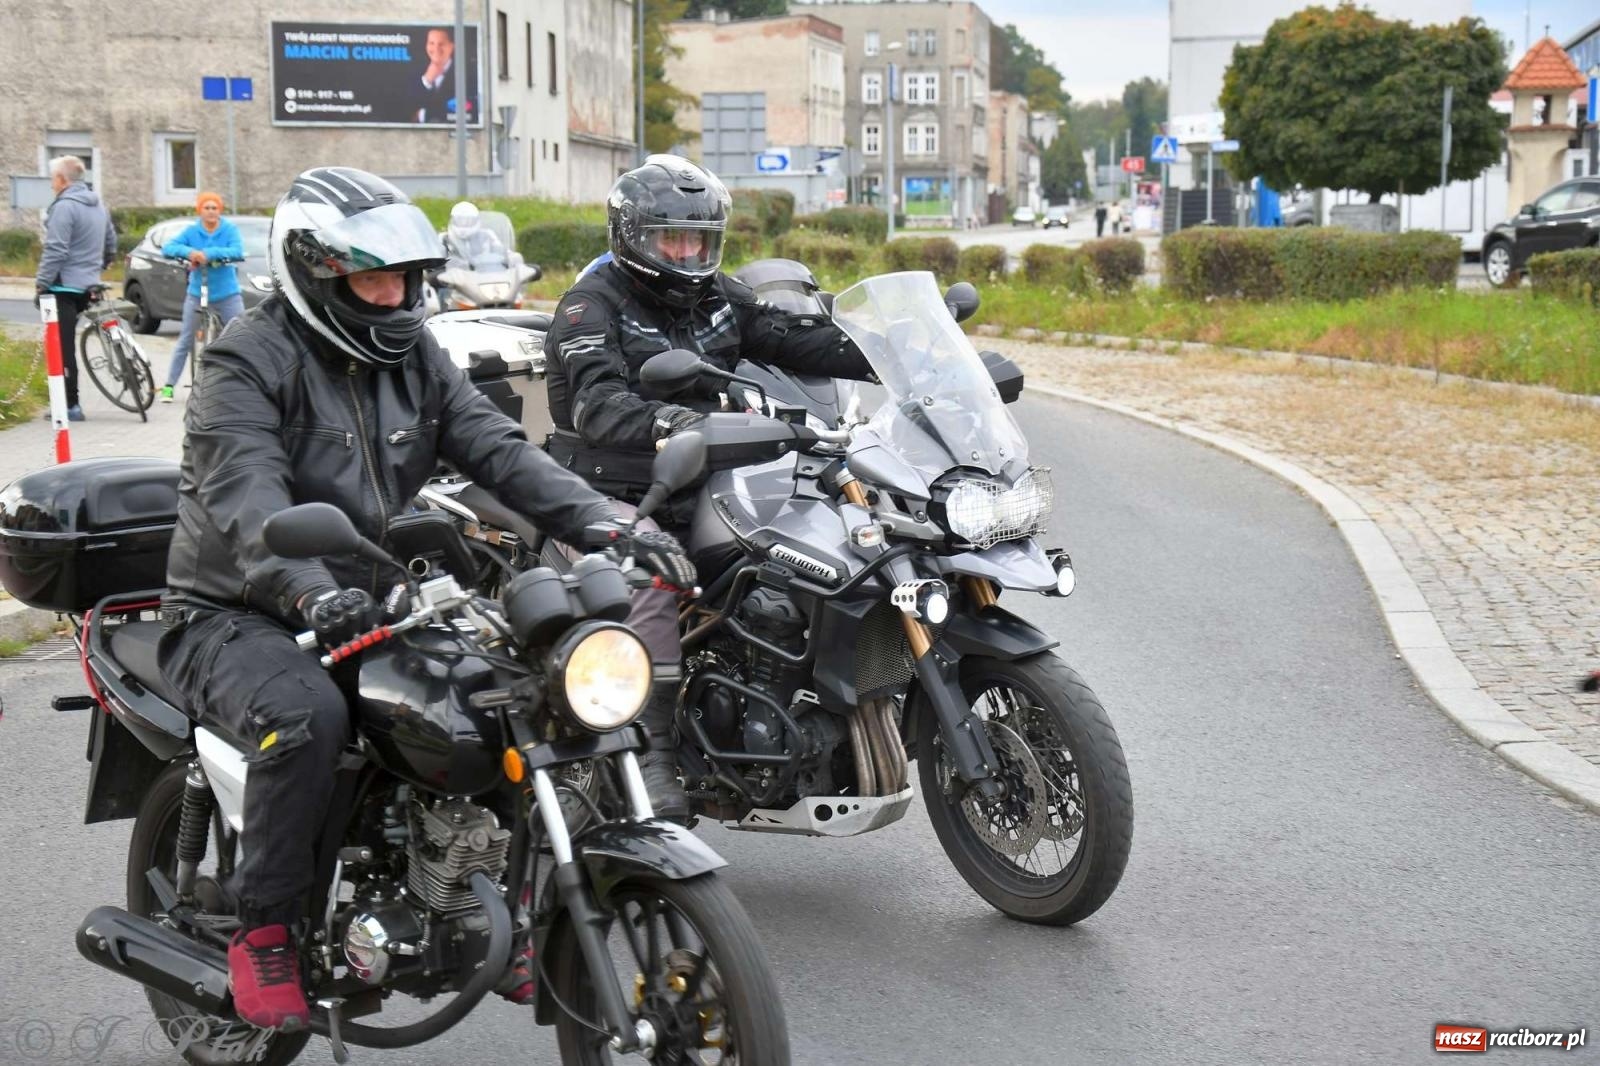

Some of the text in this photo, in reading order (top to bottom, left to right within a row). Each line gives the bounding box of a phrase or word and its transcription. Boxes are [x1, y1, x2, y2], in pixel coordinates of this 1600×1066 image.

[285, 31, 410, 44] TWÓJ AGENT NIERUCHOMOŚCI
[284, 44, 411, 61] MARCIN CHMIEL
[774, 548, 832, 579] TRIUMPH
